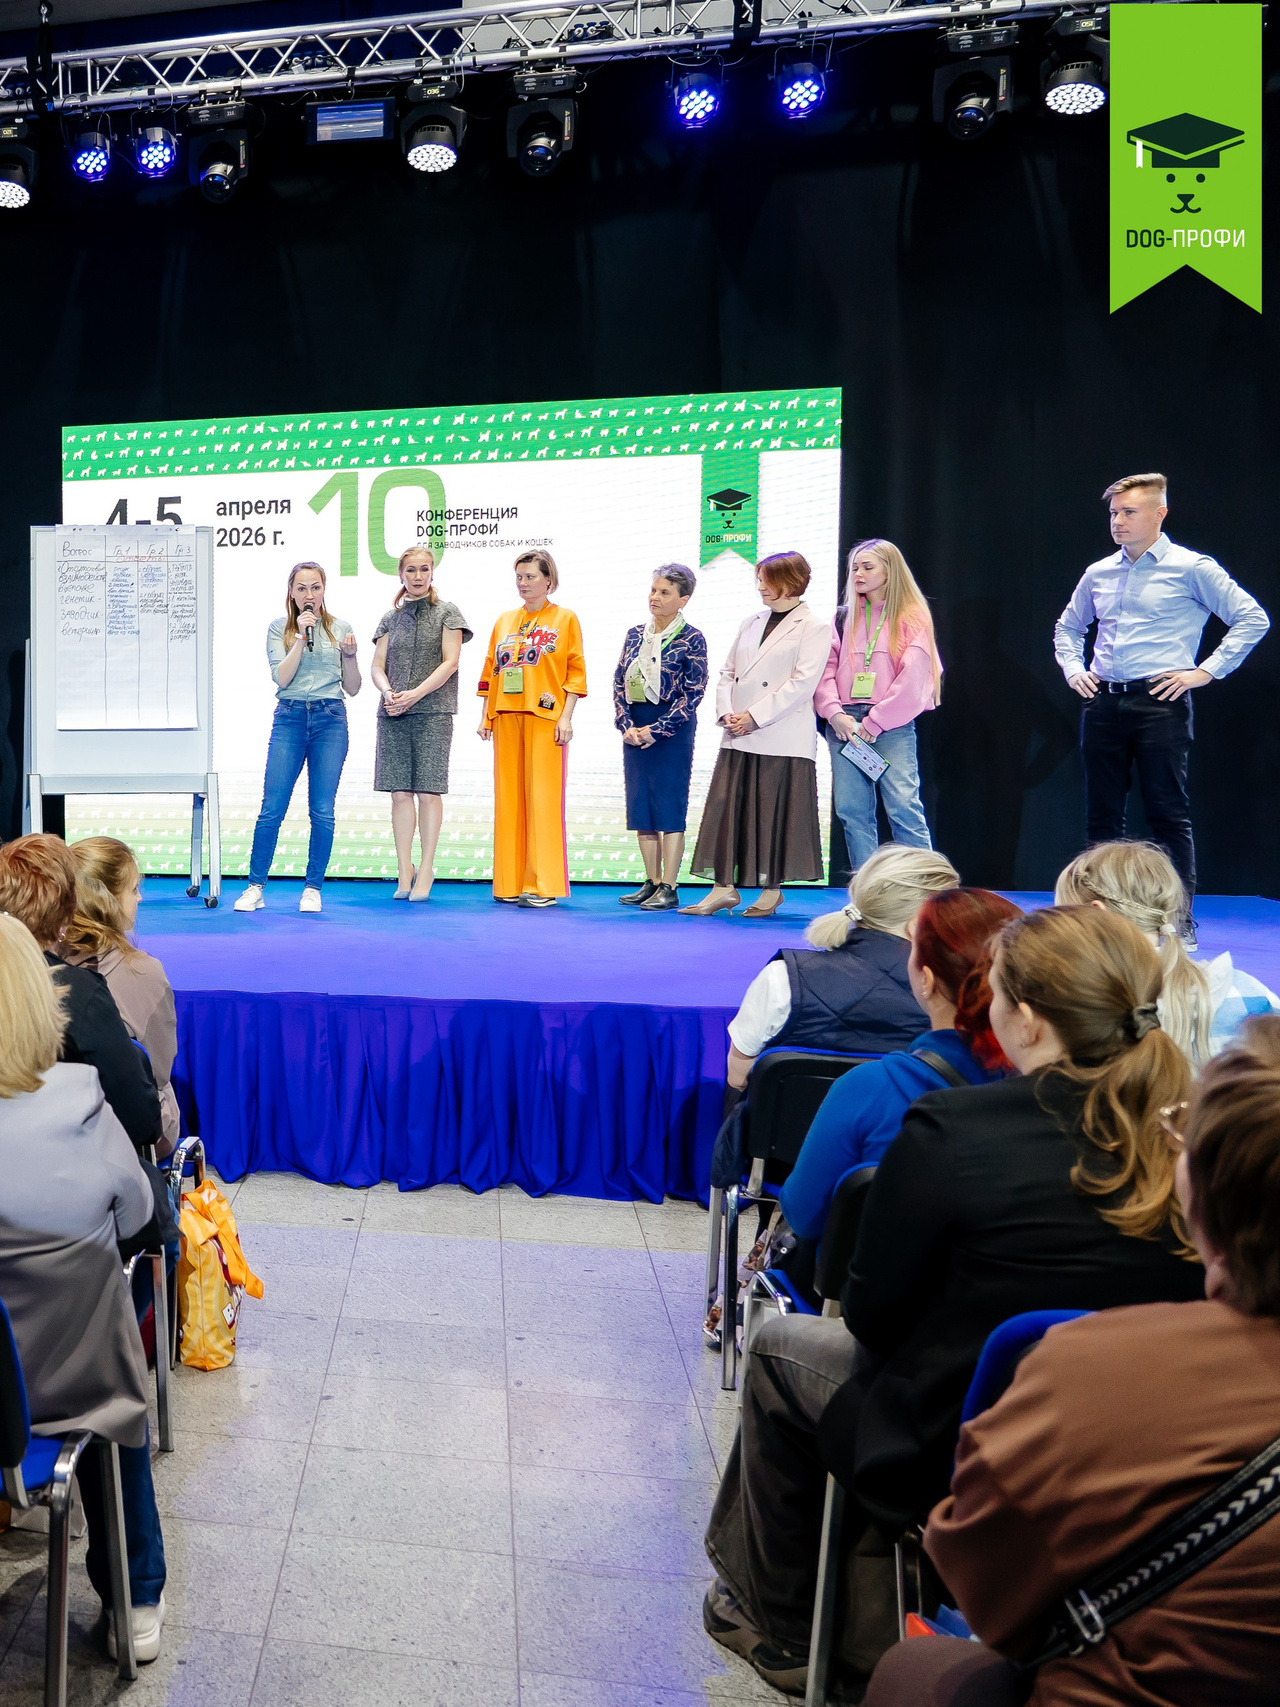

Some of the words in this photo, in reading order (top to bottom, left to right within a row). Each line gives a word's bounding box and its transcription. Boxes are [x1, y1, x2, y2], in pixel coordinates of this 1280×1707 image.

[216, 499, 291, 520] апреля
[416, 507, 518, 522] КОНФЕРЕНЦИЯ
[307, 468, 447, 577] 10
[416, 523, 498, 537] DOG-ПРОФИ
[216, 527, 266, 548] 2026
[273, 530, 285, 546] г.
[434, 541, 487, 550] ЗАВОДЧИКОВ
[489, 539, 516, 548] СОБАК
[525, 538, 554, 546] КОШЕК
[705, 533, 752, 543] DOG-ПРОФИ
